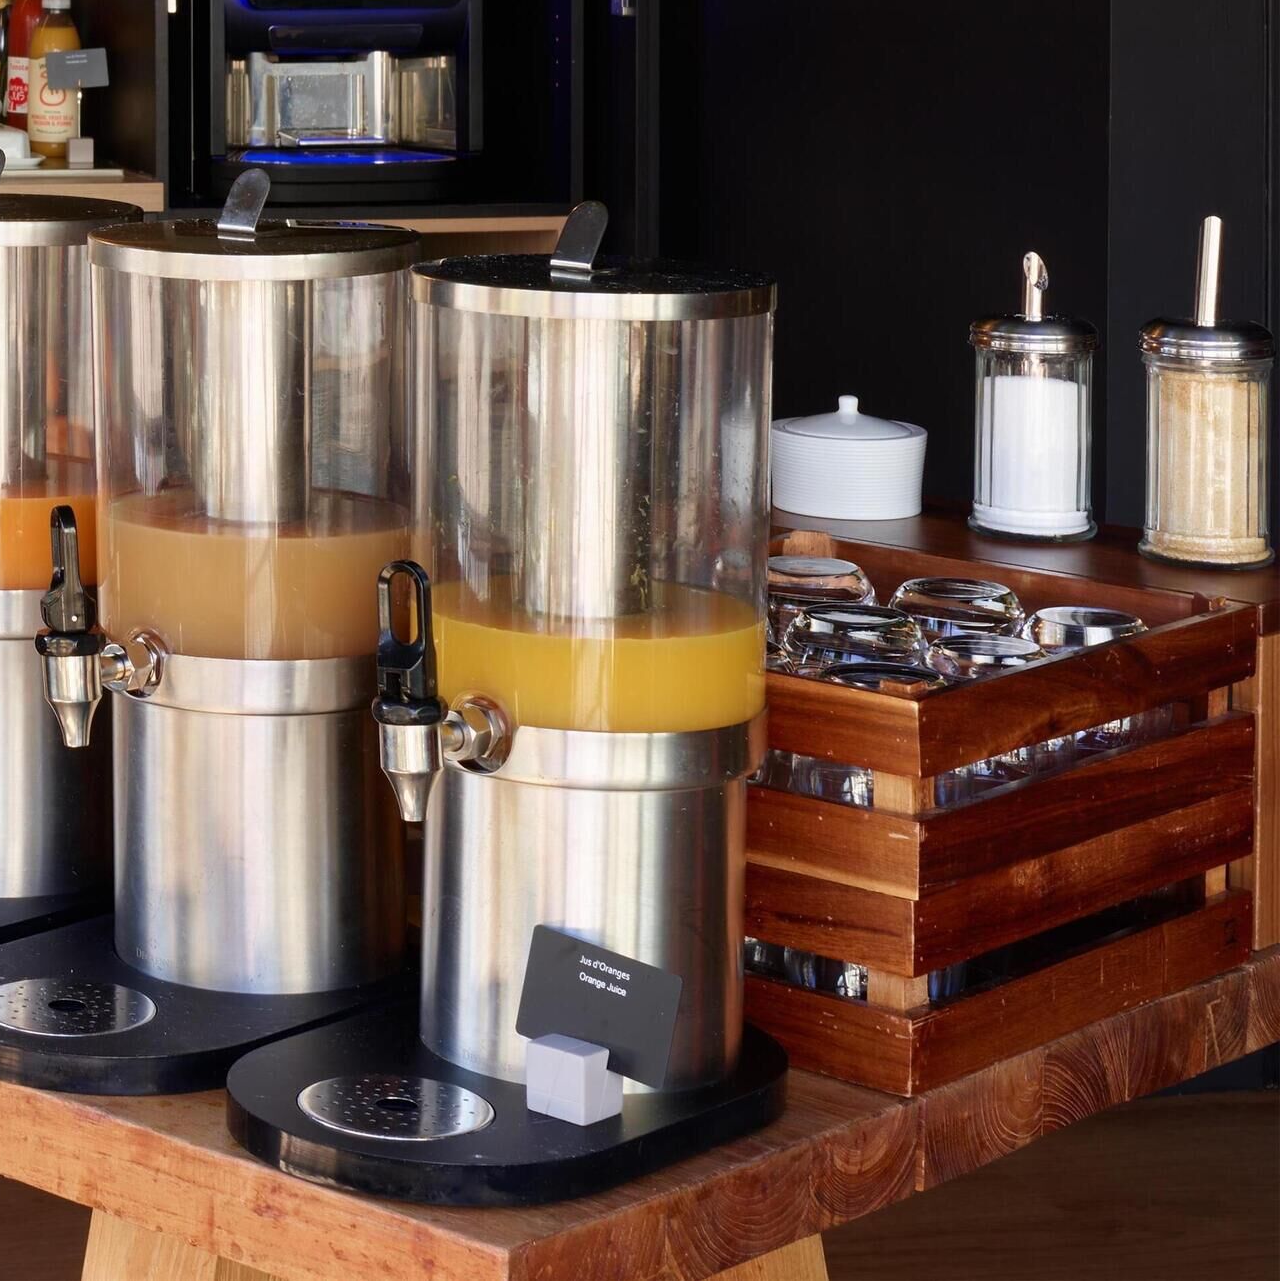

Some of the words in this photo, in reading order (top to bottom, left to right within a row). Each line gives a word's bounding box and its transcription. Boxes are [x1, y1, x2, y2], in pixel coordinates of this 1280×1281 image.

[579, 955, 592, 966] Jus
[592, 960, 630, 980] d'Oranges
[579, 971, 606, 989] Orange
[606, 983, 627, 997] Juice
